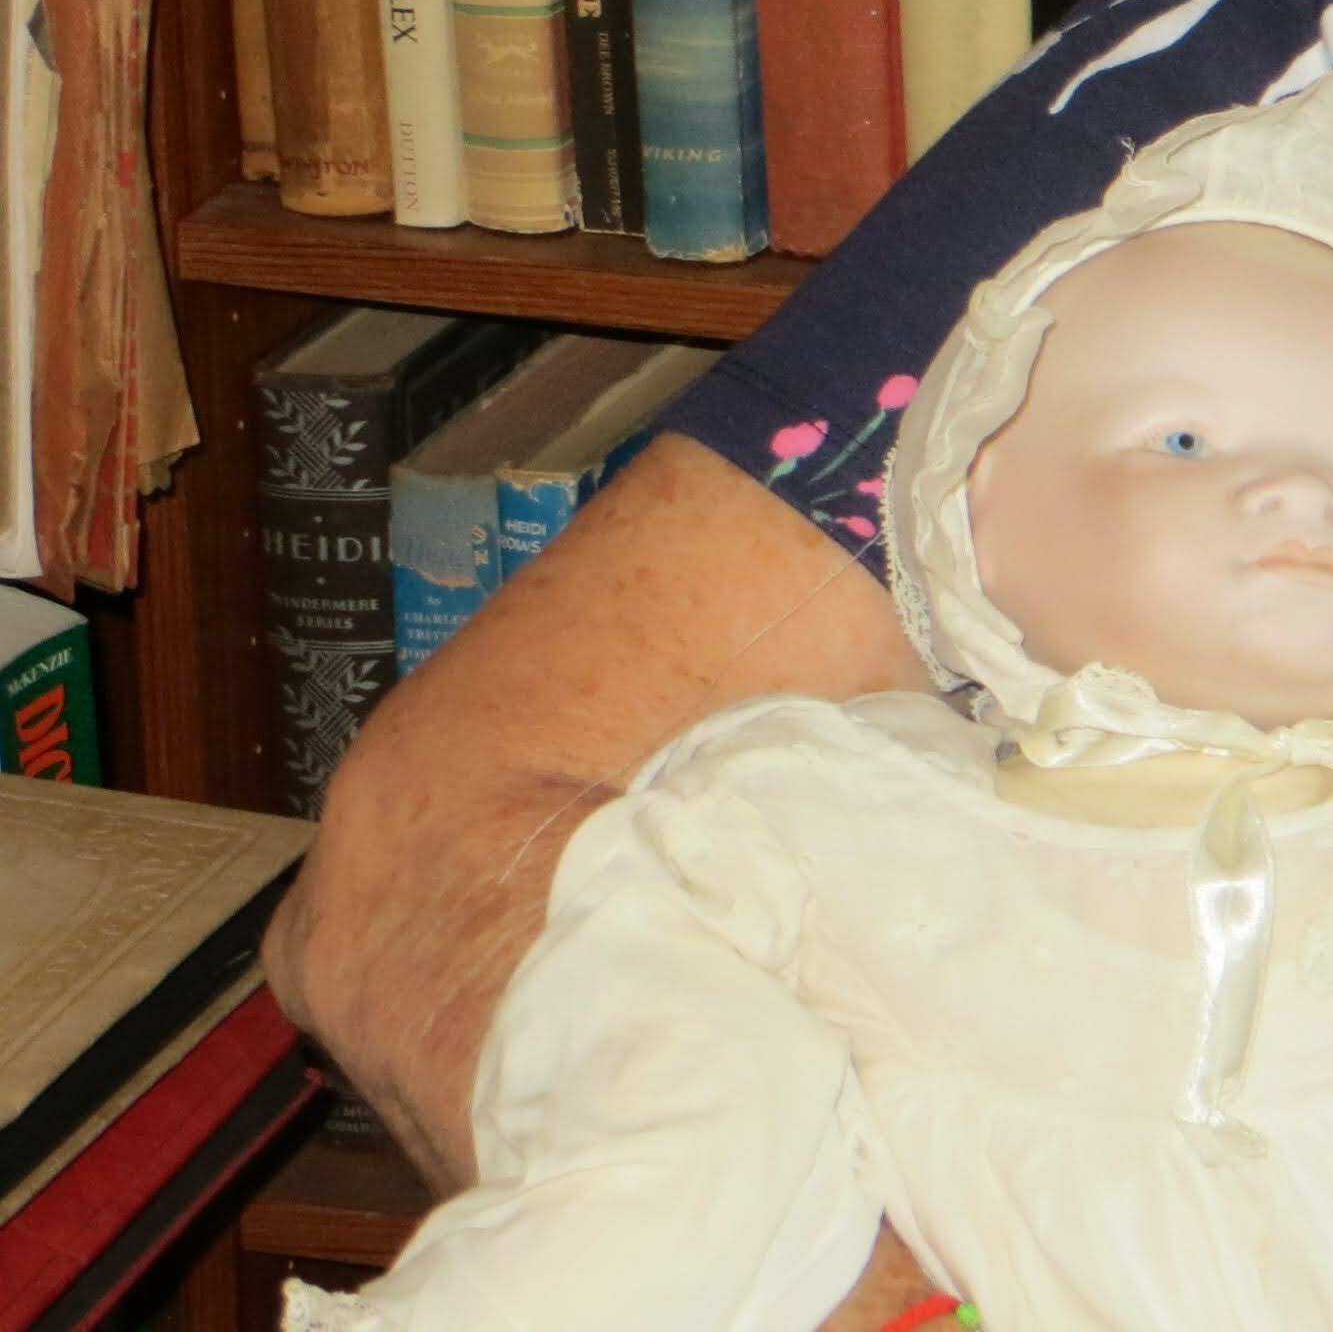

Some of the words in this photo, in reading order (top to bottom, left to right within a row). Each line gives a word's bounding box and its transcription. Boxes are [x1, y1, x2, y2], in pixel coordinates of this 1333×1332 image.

[641, 146, 721, 162] VIKING
[505, 520, 547, 536] HEIDI
[264, 528, 383, 563] HEIDI
